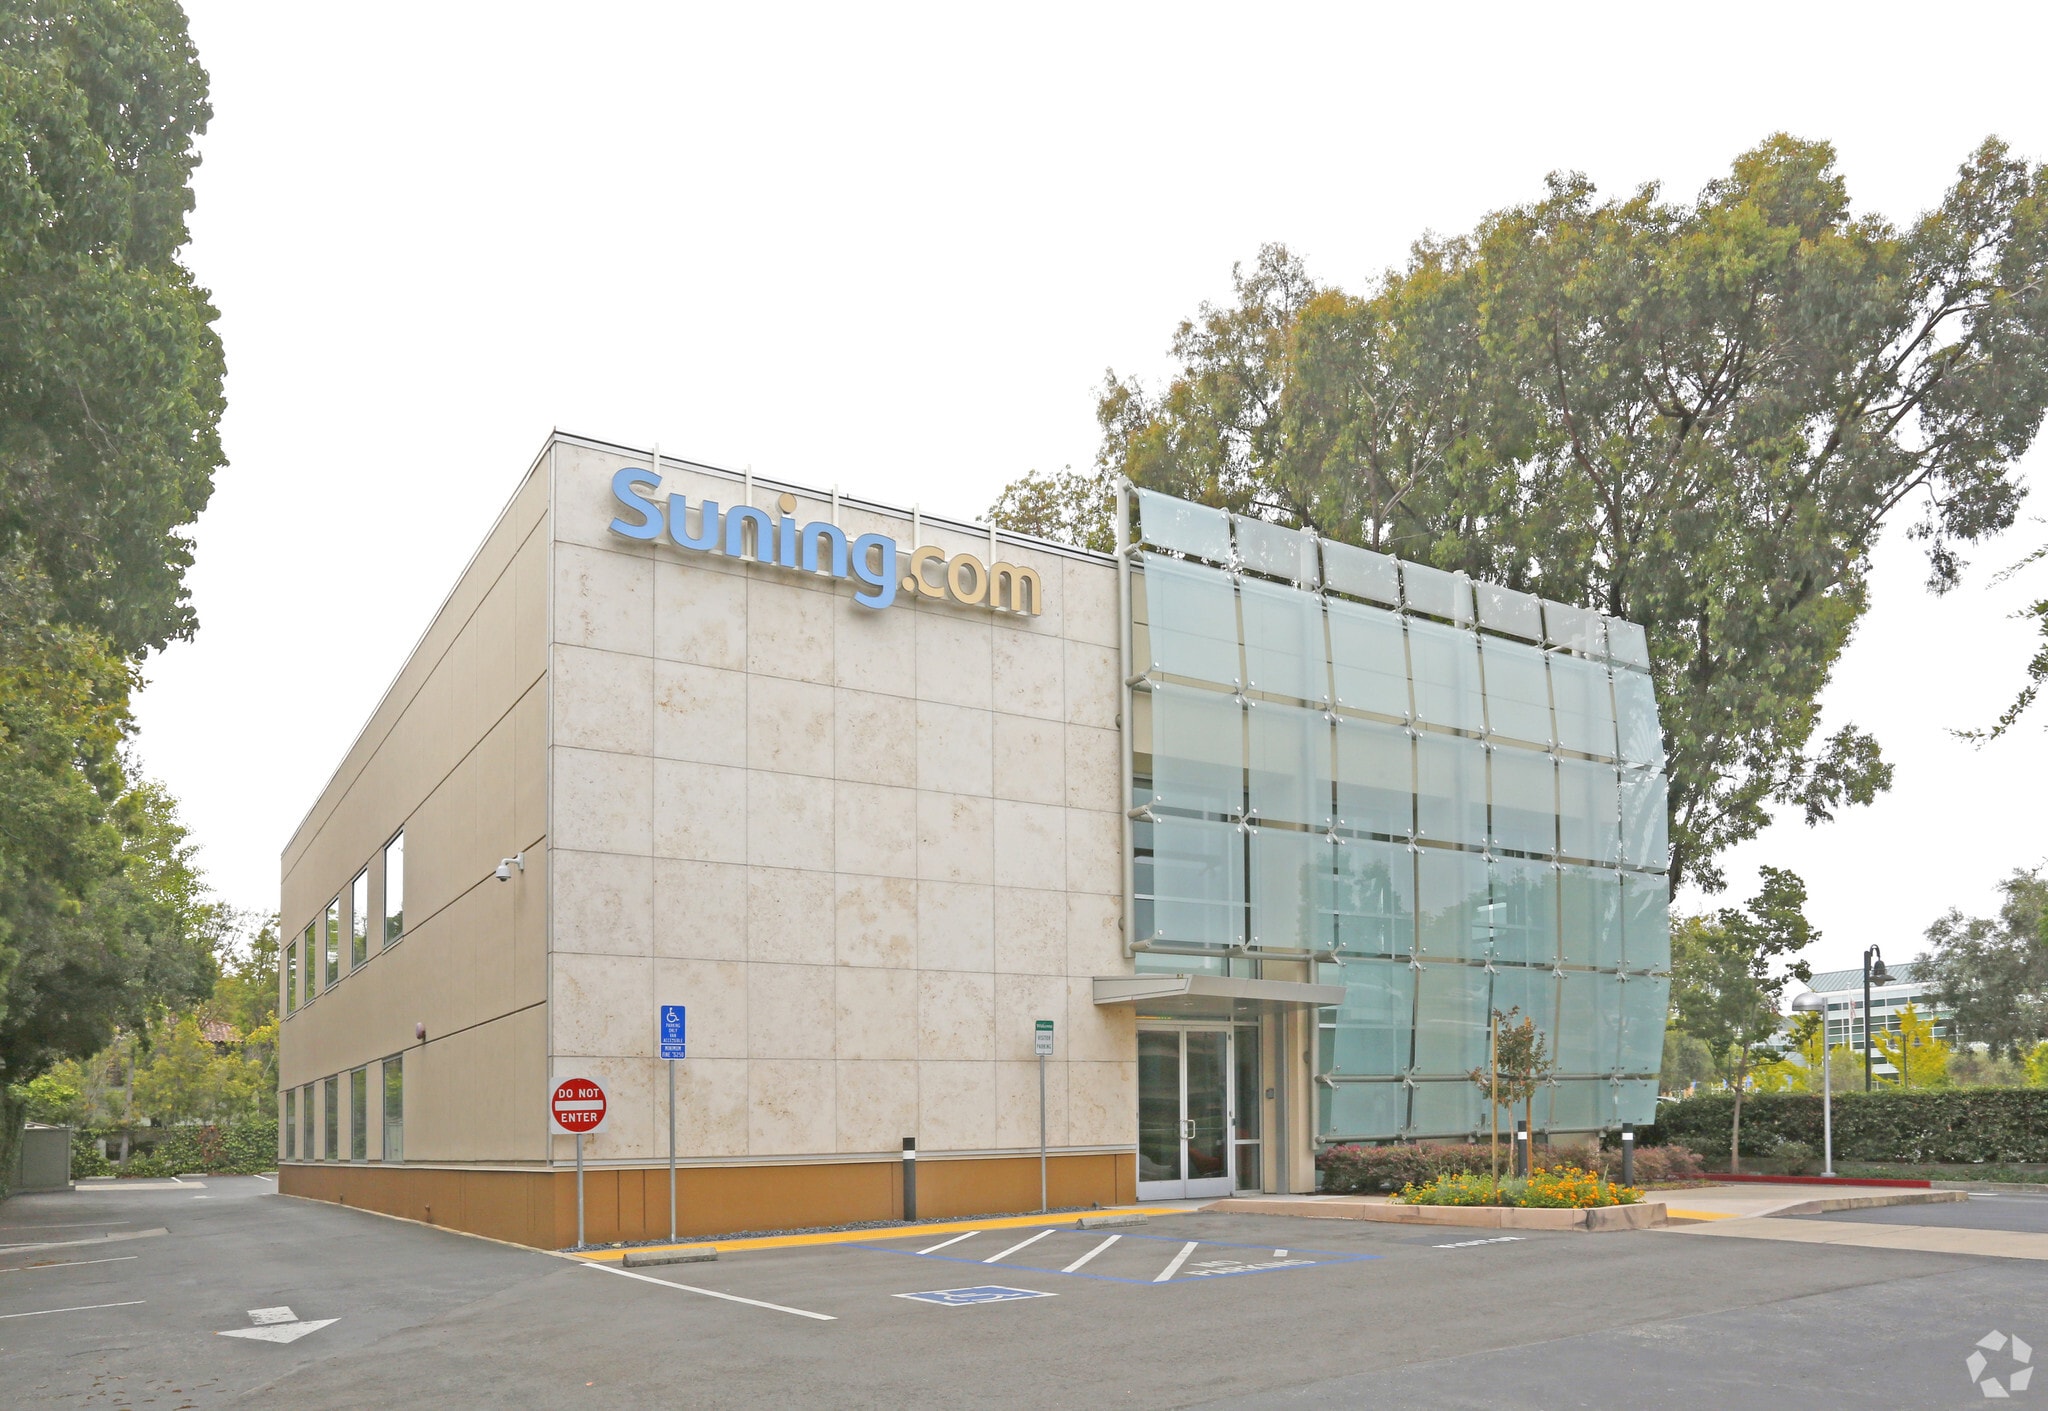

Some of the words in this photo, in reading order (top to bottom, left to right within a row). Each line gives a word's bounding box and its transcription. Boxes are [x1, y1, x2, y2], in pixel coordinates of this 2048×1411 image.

[608, 467, 1042, 616] Suning.com
[558, 1089, 573, 1098] DO
[578, 1088, 599, 1098] NOT
[561, 1112, 597, 1123] ENTER
